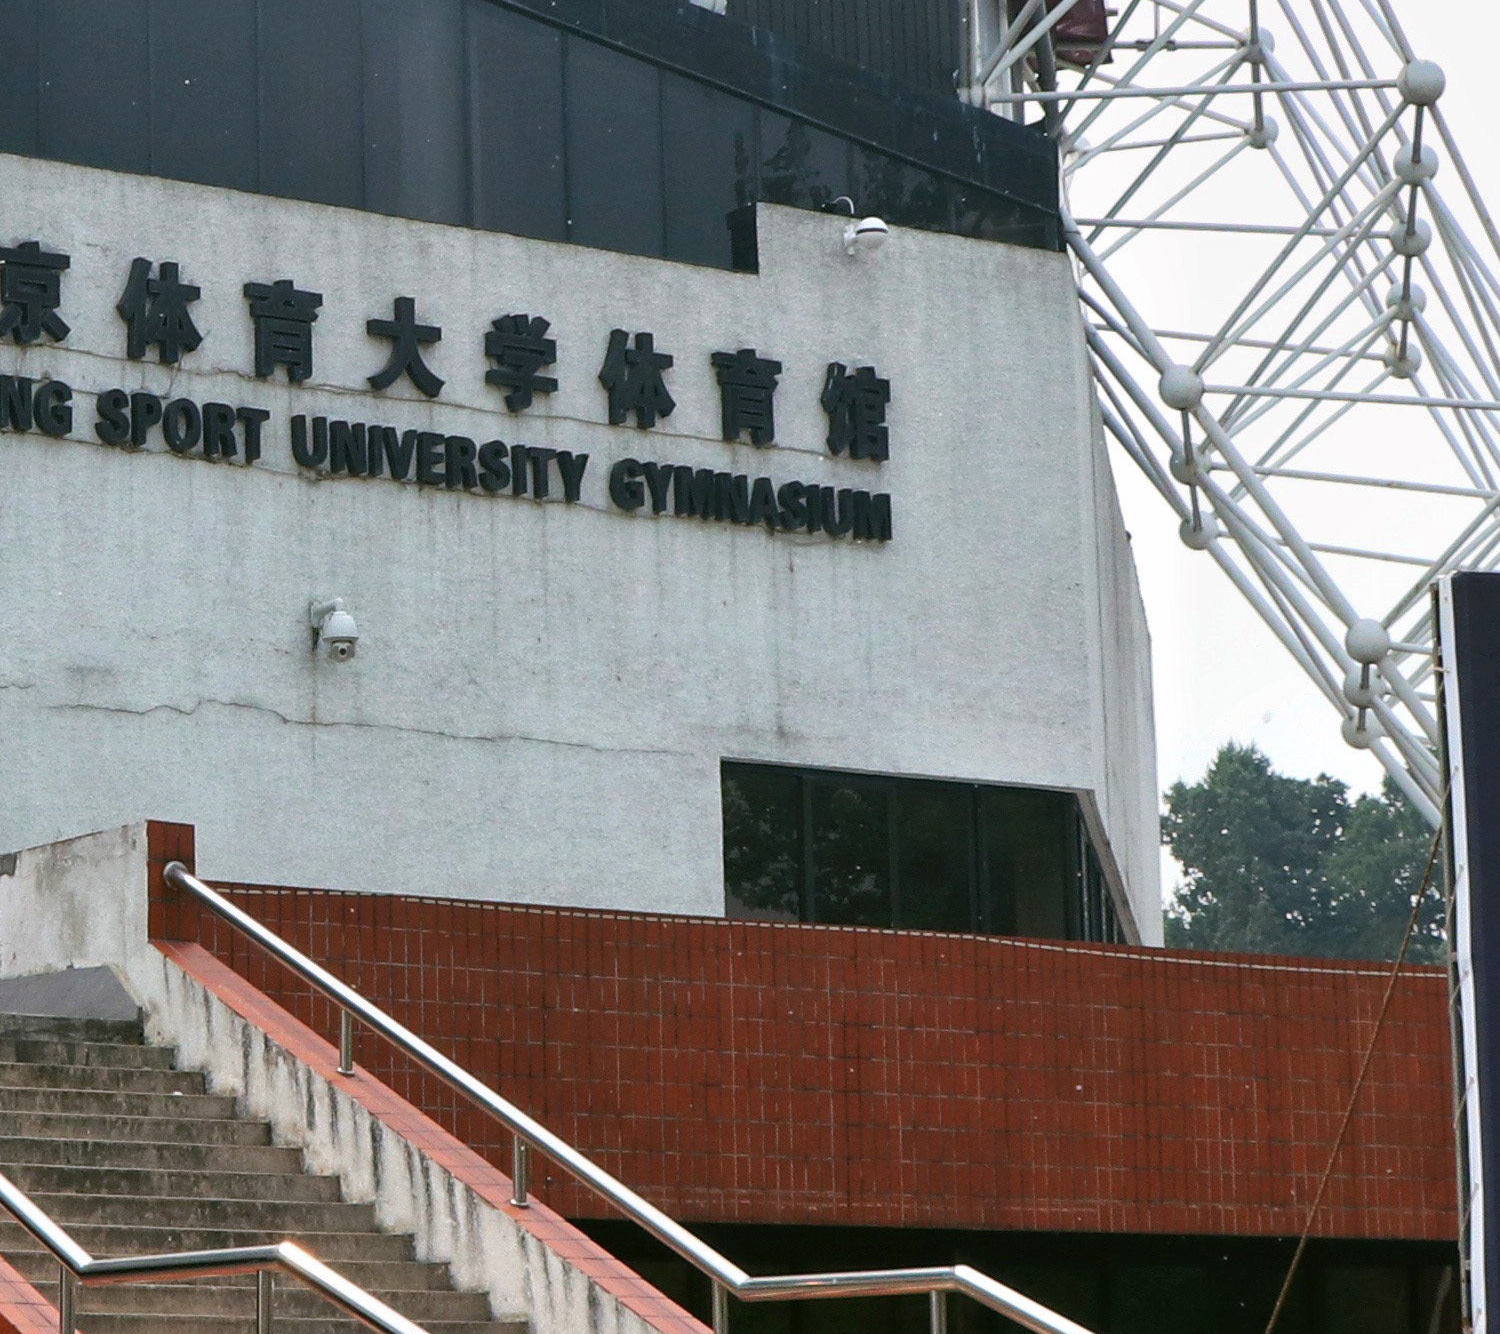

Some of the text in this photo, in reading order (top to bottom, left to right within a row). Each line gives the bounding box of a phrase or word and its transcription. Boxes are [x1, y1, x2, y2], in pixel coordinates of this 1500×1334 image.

[96, 388, 270, 465] SPORT
[291, 415, 589, 503] UNIVERSITY
[609, 456, 893, 544] GYMNASIUM
